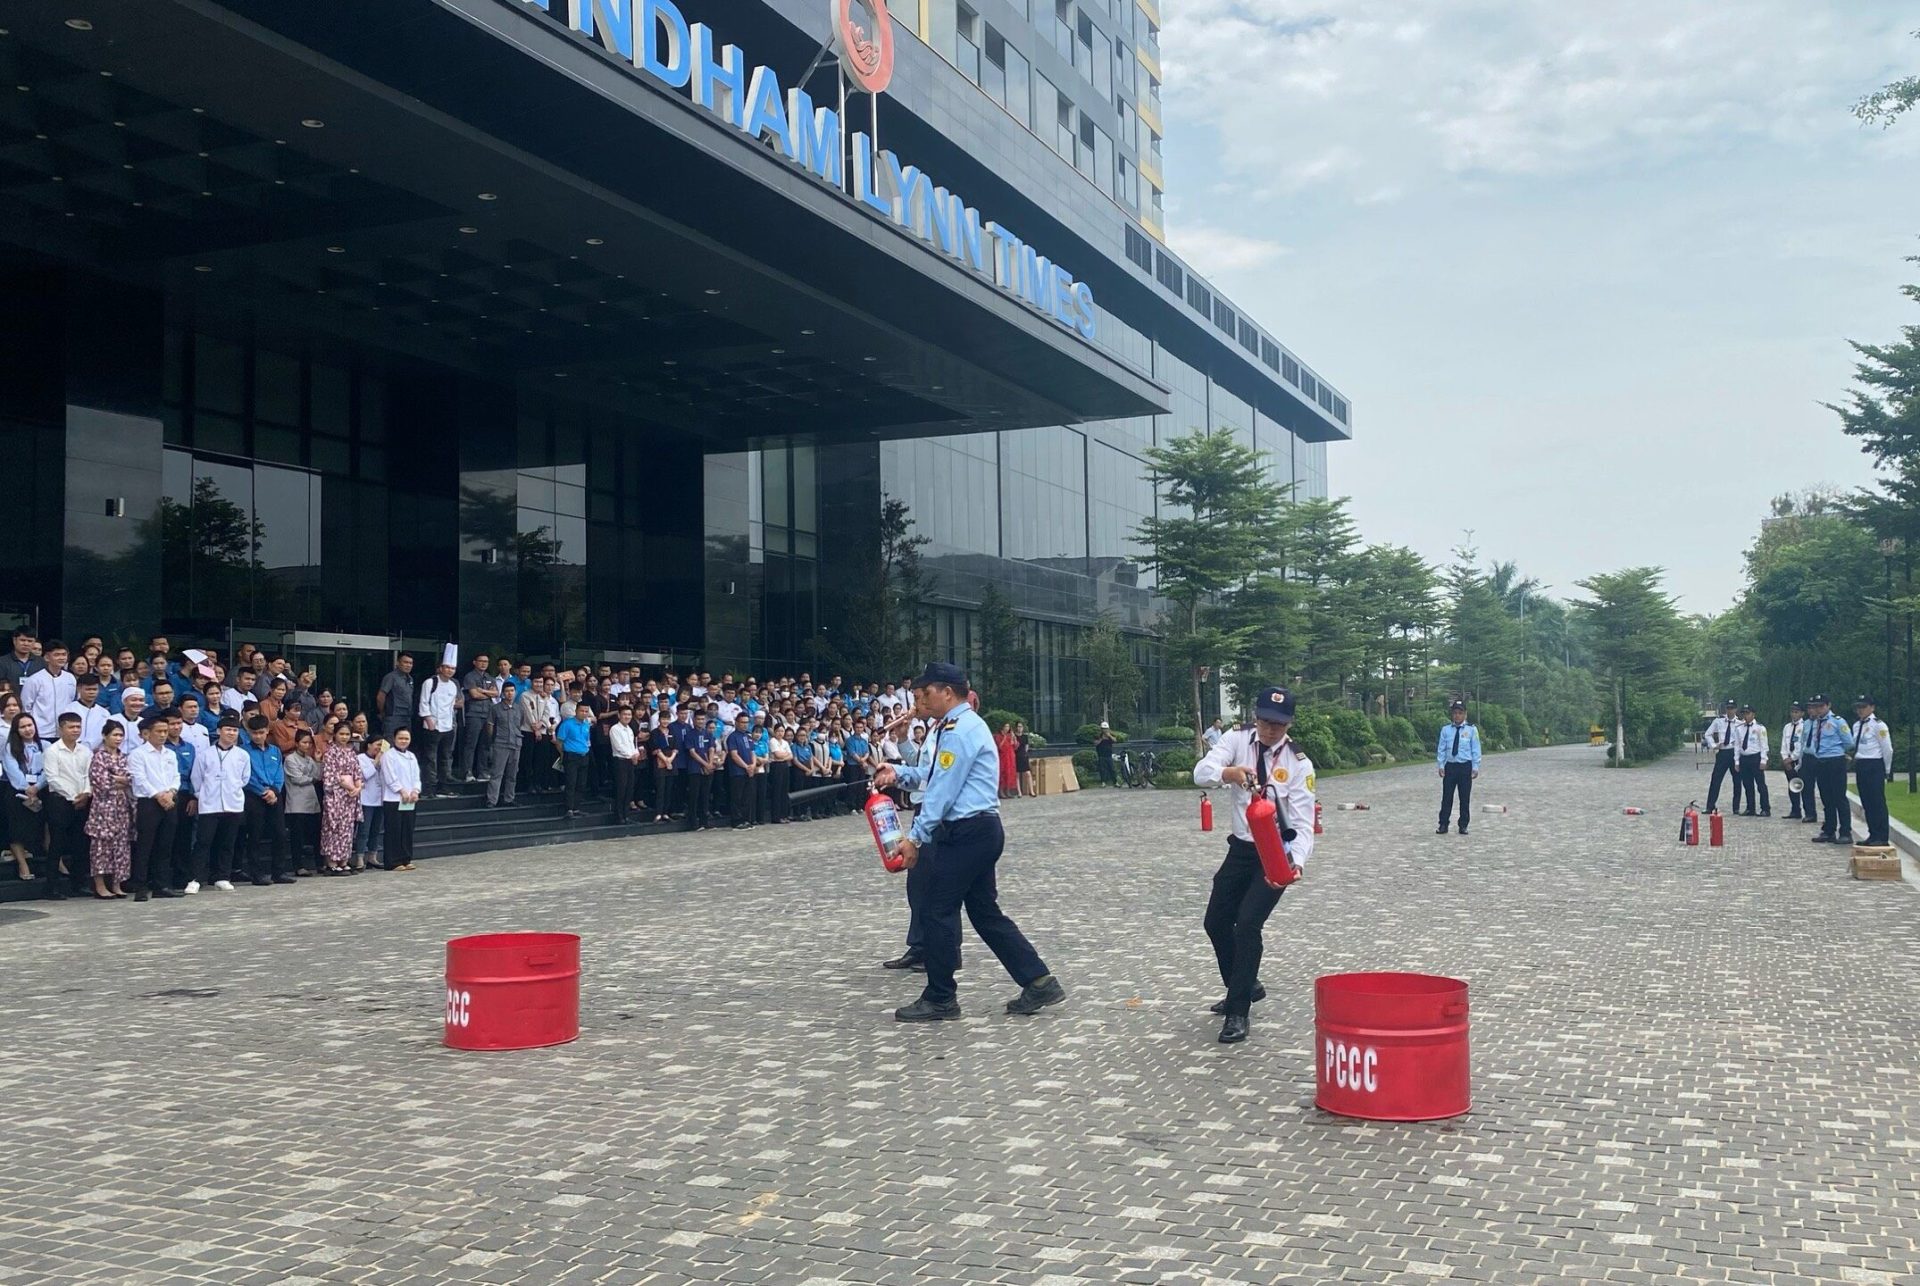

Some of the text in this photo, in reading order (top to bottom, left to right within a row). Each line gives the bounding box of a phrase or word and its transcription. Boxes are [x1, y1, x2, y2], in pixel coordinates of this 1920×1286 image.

[852, 132, 982, 271] LYNN
[985, 220, 1096, 340] TIMES
[1325, 1037, 1378, 1093] PCCC
